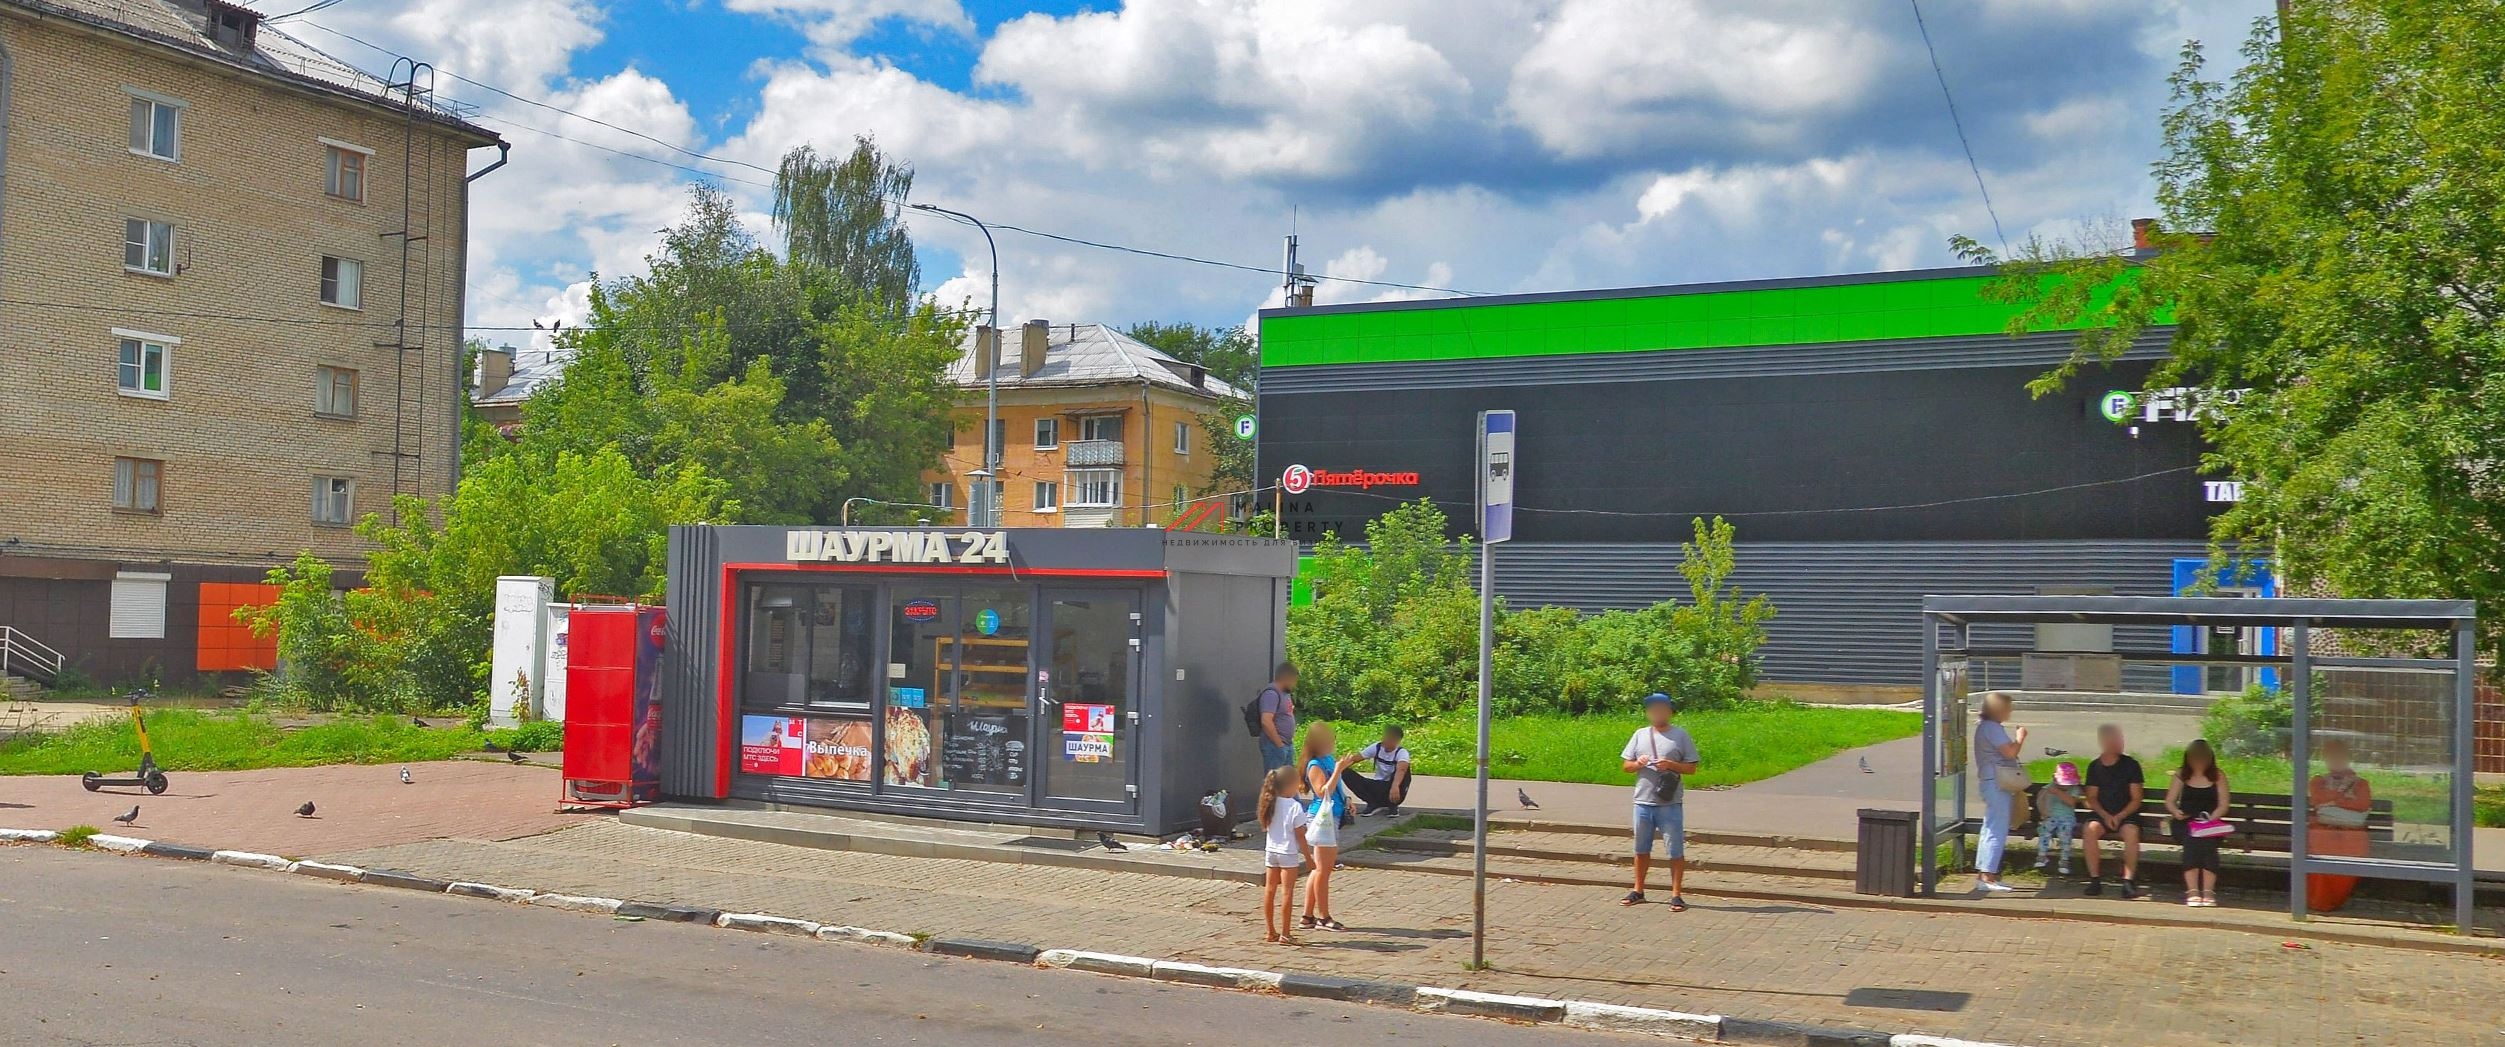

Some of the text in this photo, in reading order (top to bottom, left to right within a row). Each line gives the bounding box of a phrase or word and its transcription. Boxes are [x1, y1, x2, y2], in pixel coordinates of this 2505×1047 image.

[1241, 421, 1250, 434] F
[1313, 469, 1419, 489] Пятёрочка
[787, 531, 1009, 563] ШАУРМА 24
[809, 740, 868, 757] Выпечка
[1068, 742, 1108, 753] ШАУРМА
